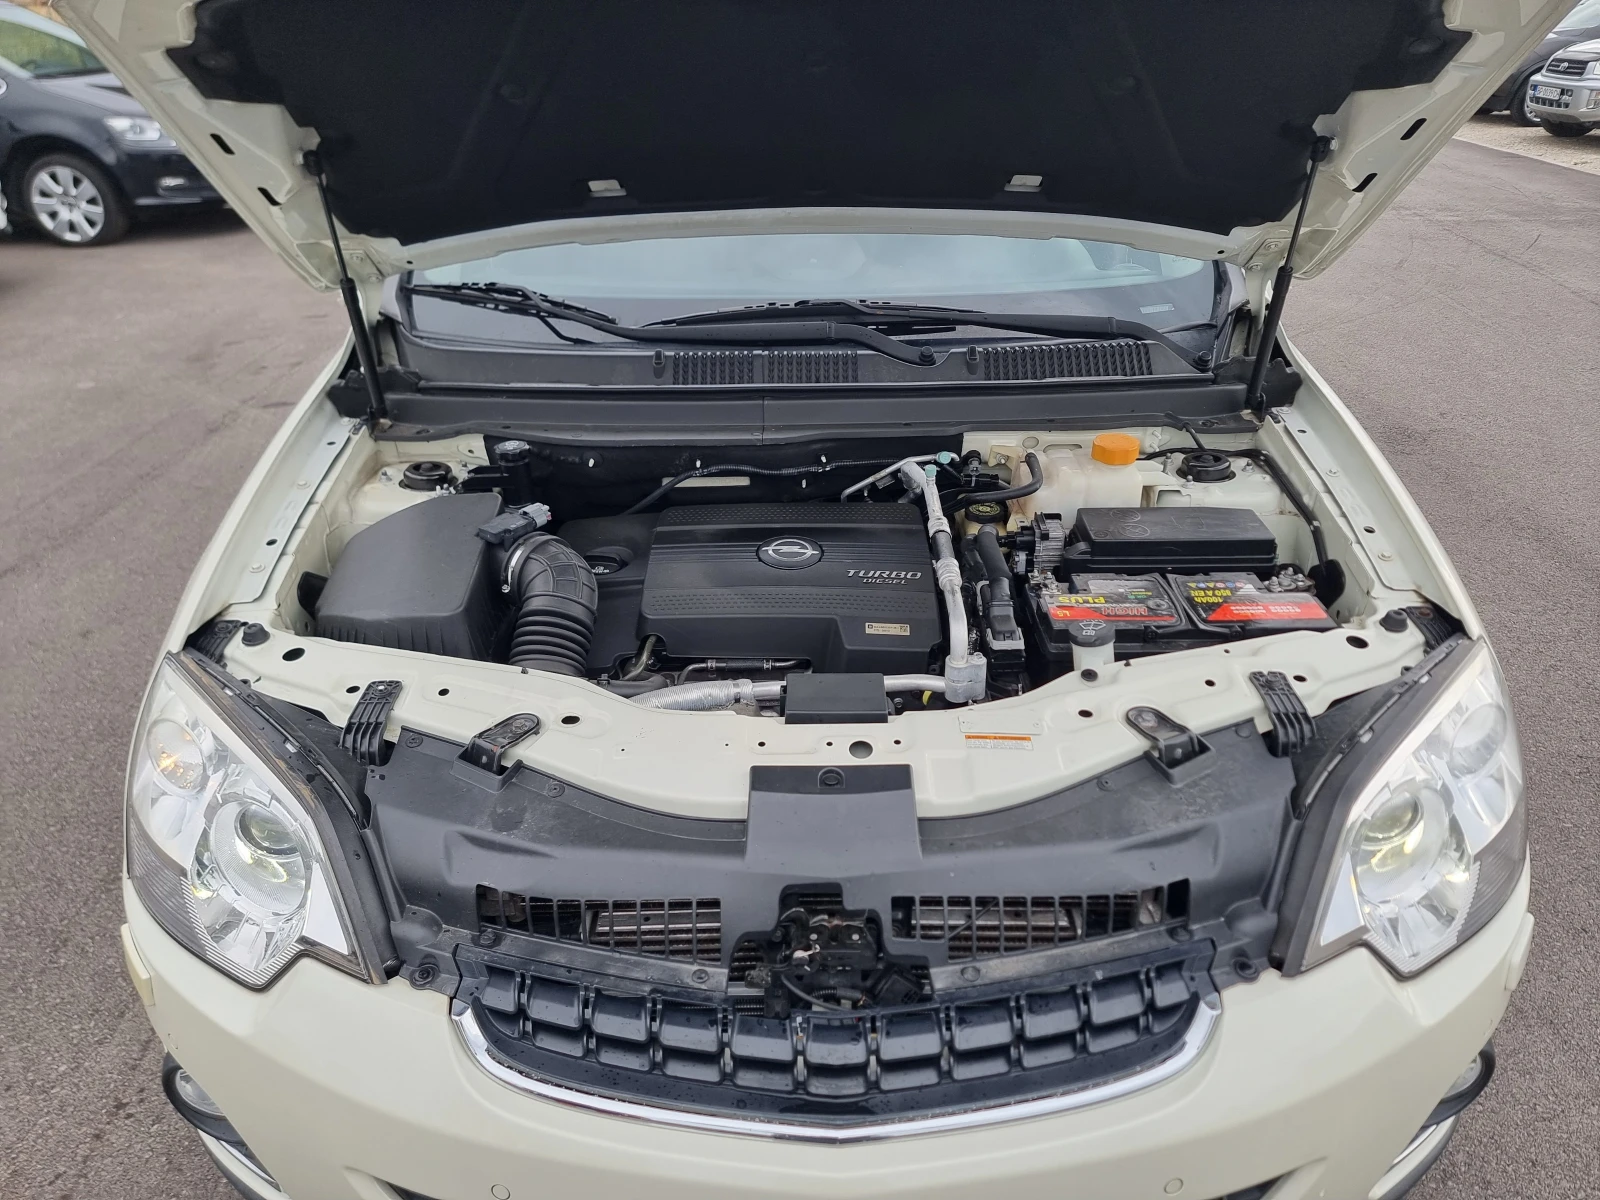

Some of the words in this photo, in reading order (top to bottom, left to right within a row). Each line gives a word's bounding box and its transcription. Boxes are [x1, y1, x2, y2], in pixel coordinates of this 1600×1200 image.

[847, 569, 922, 579] TURBO
[1058, 595, 1106, 604] PLUS
[1194, 596, 1224, 604] 100Ah
[1101, 606, 1148, 616] HIGH
